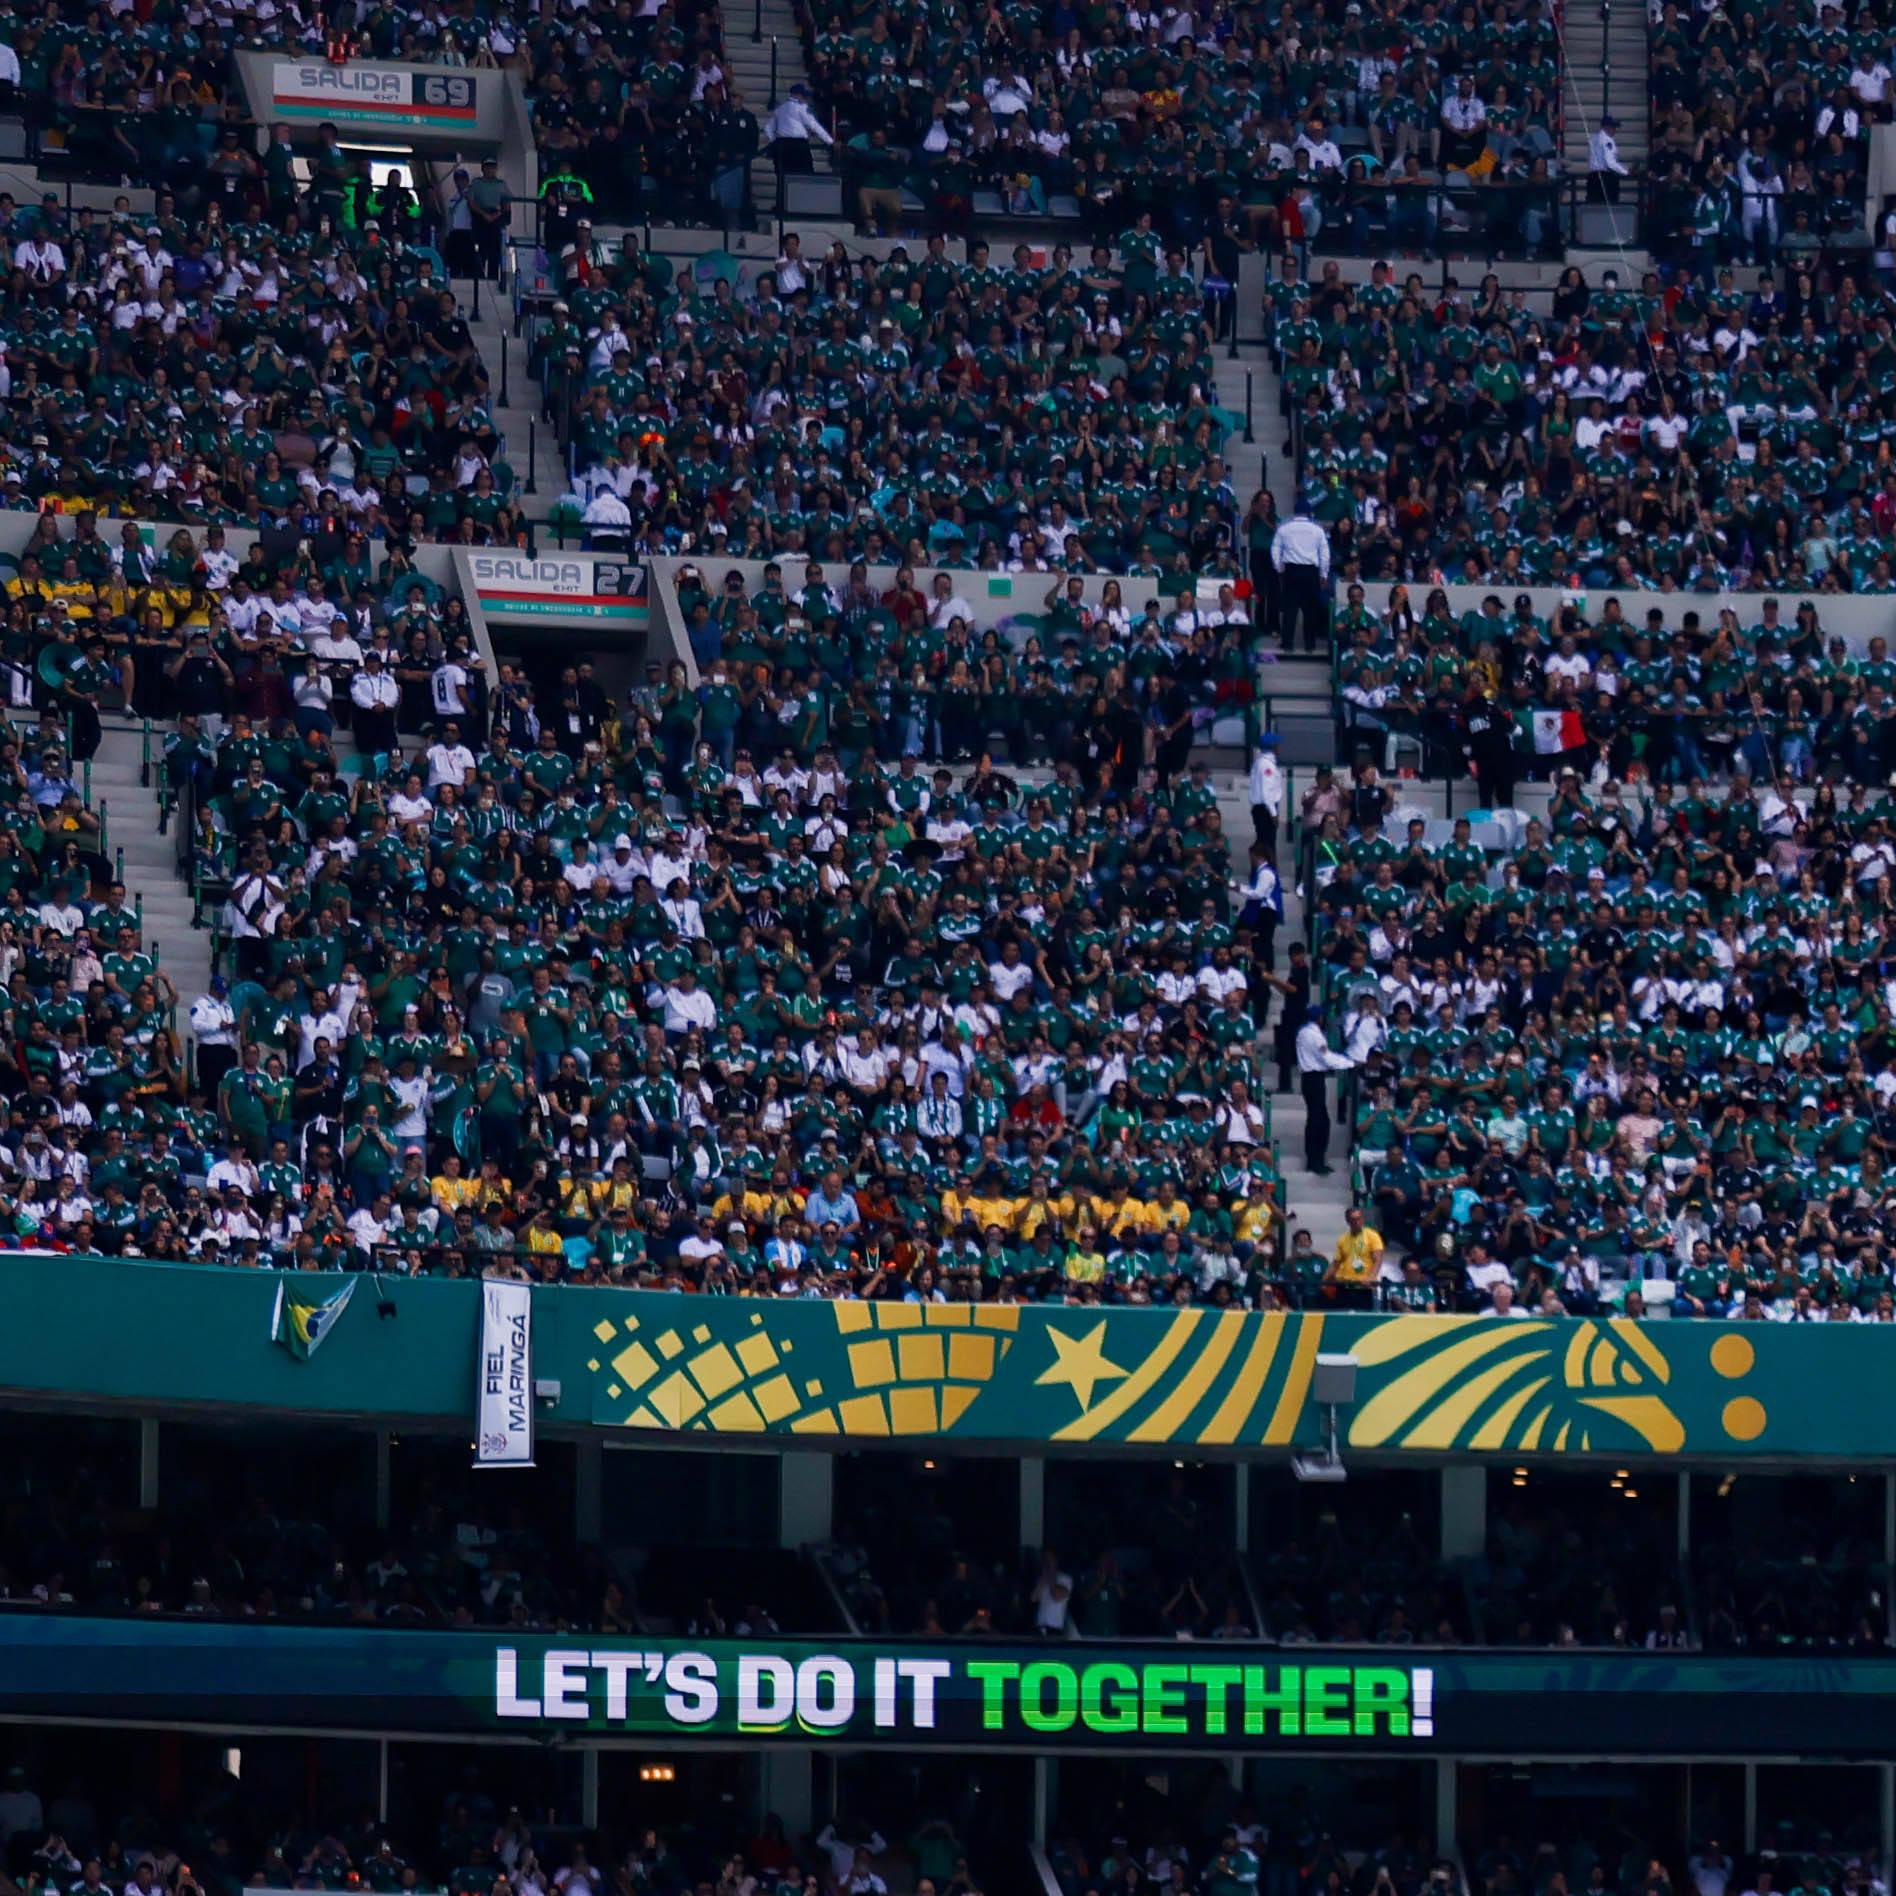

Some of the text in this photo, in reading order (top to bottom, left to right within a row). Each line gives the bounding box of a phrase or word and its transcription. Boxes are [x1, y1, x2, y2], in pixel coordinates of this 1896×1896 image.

[300, 68, 401, 92] SALIDA
[425, 77, 469, 106] 69
[475, 559, 581, 583] SALIDA
[597, 565, 644, 595] 27
[486, 1344, 504, 1396] FIEL
[507, 1313, 527, 1433] MARINGÁ
[496, 1648, 1434, 1737] LET'S DO IT TOGETHER!
